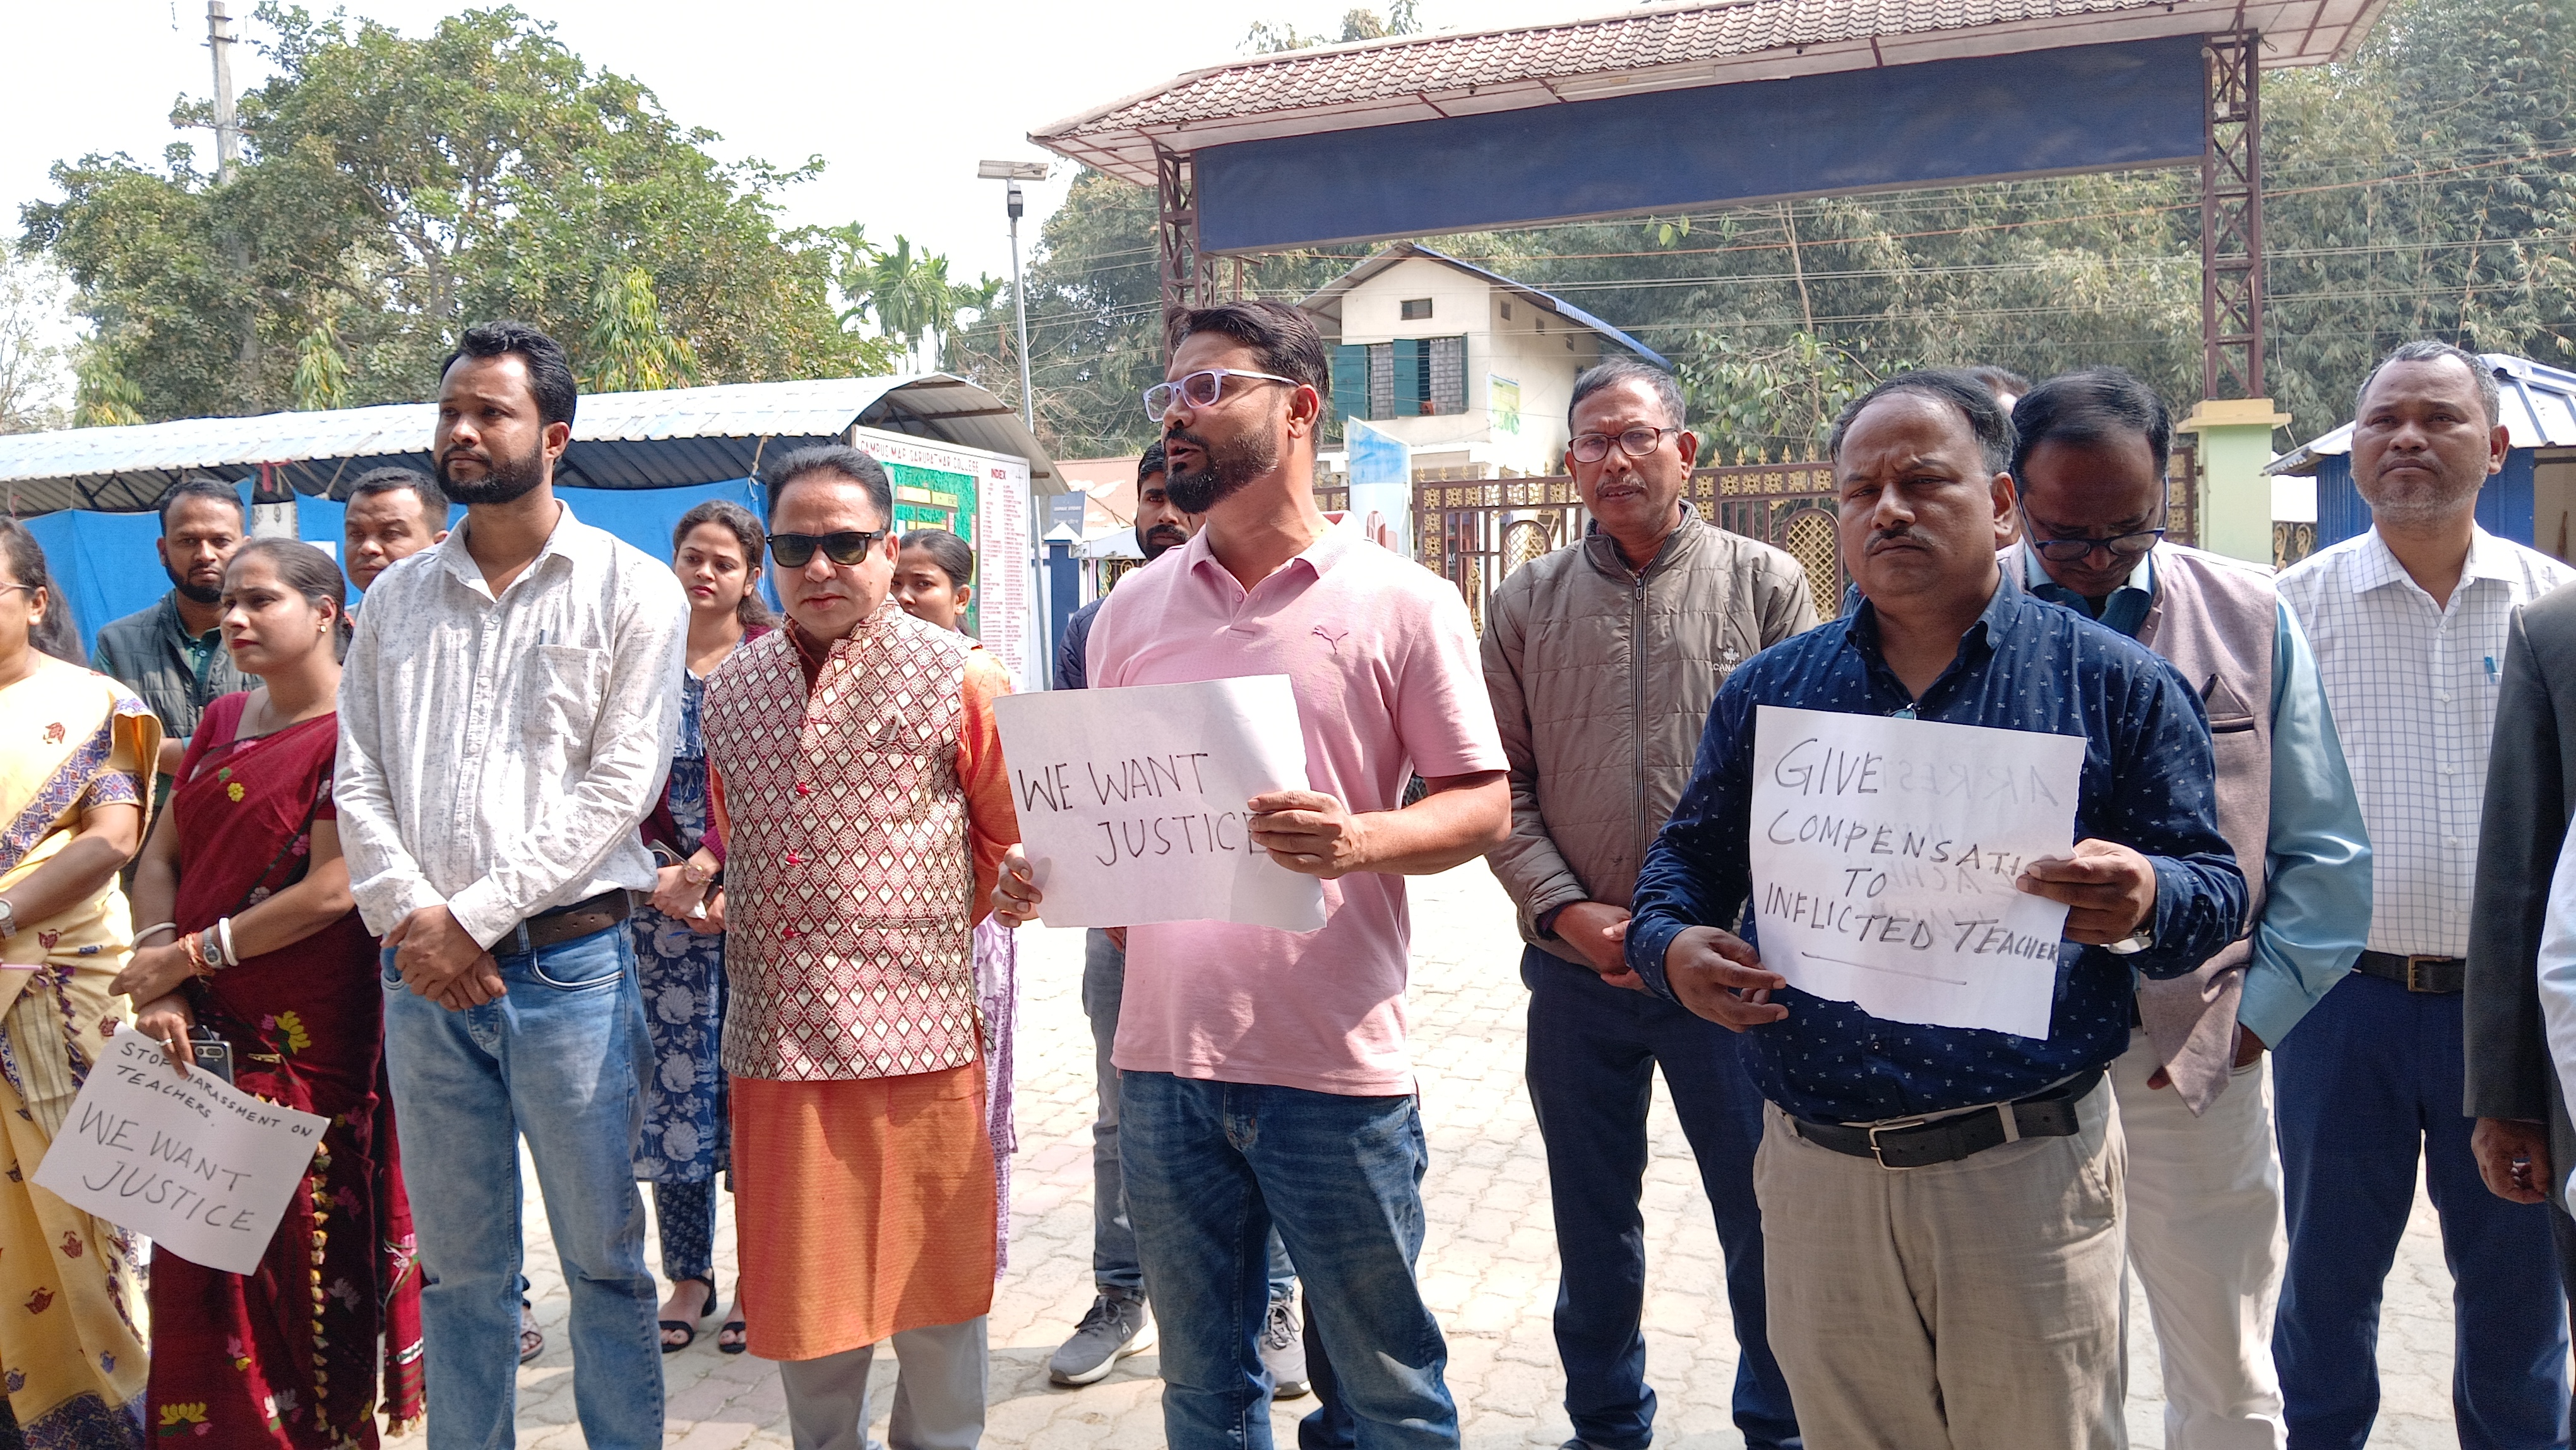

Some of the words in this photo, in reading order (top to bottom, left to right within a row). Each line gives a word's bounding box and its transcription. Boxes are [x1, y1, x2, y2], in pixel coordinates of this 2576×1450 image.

[861, 441, 889, 458] CAMPUS
[891, 446, 906, 460] MAP
[953, 457, 979, 473] COLLEGE
[991, 468, 1006, 480] INDEX
[1713, 663, 1739, 672] CANA
[1018, 763, 1073, 812] WE
[1087, 753, 1208, 806] WANT
[1775, 738, 1882, 796] GIVE
[1768, 809, 2024, 877] COMPENSATI
[1845, 868, 1887, 898] TO
[1765, 882, 1933, 951] INFLICTED
[1954, 919, 2058, 966] TEACHER
[121, 1041, 171, 1067] STOP
[291, 1124, 313, 1137] ON
[79, 1101, 139, 1153] WE
[150, 1130, 252, 1192] WANT
[83, 1161, 256, 1231] JUSTICE
